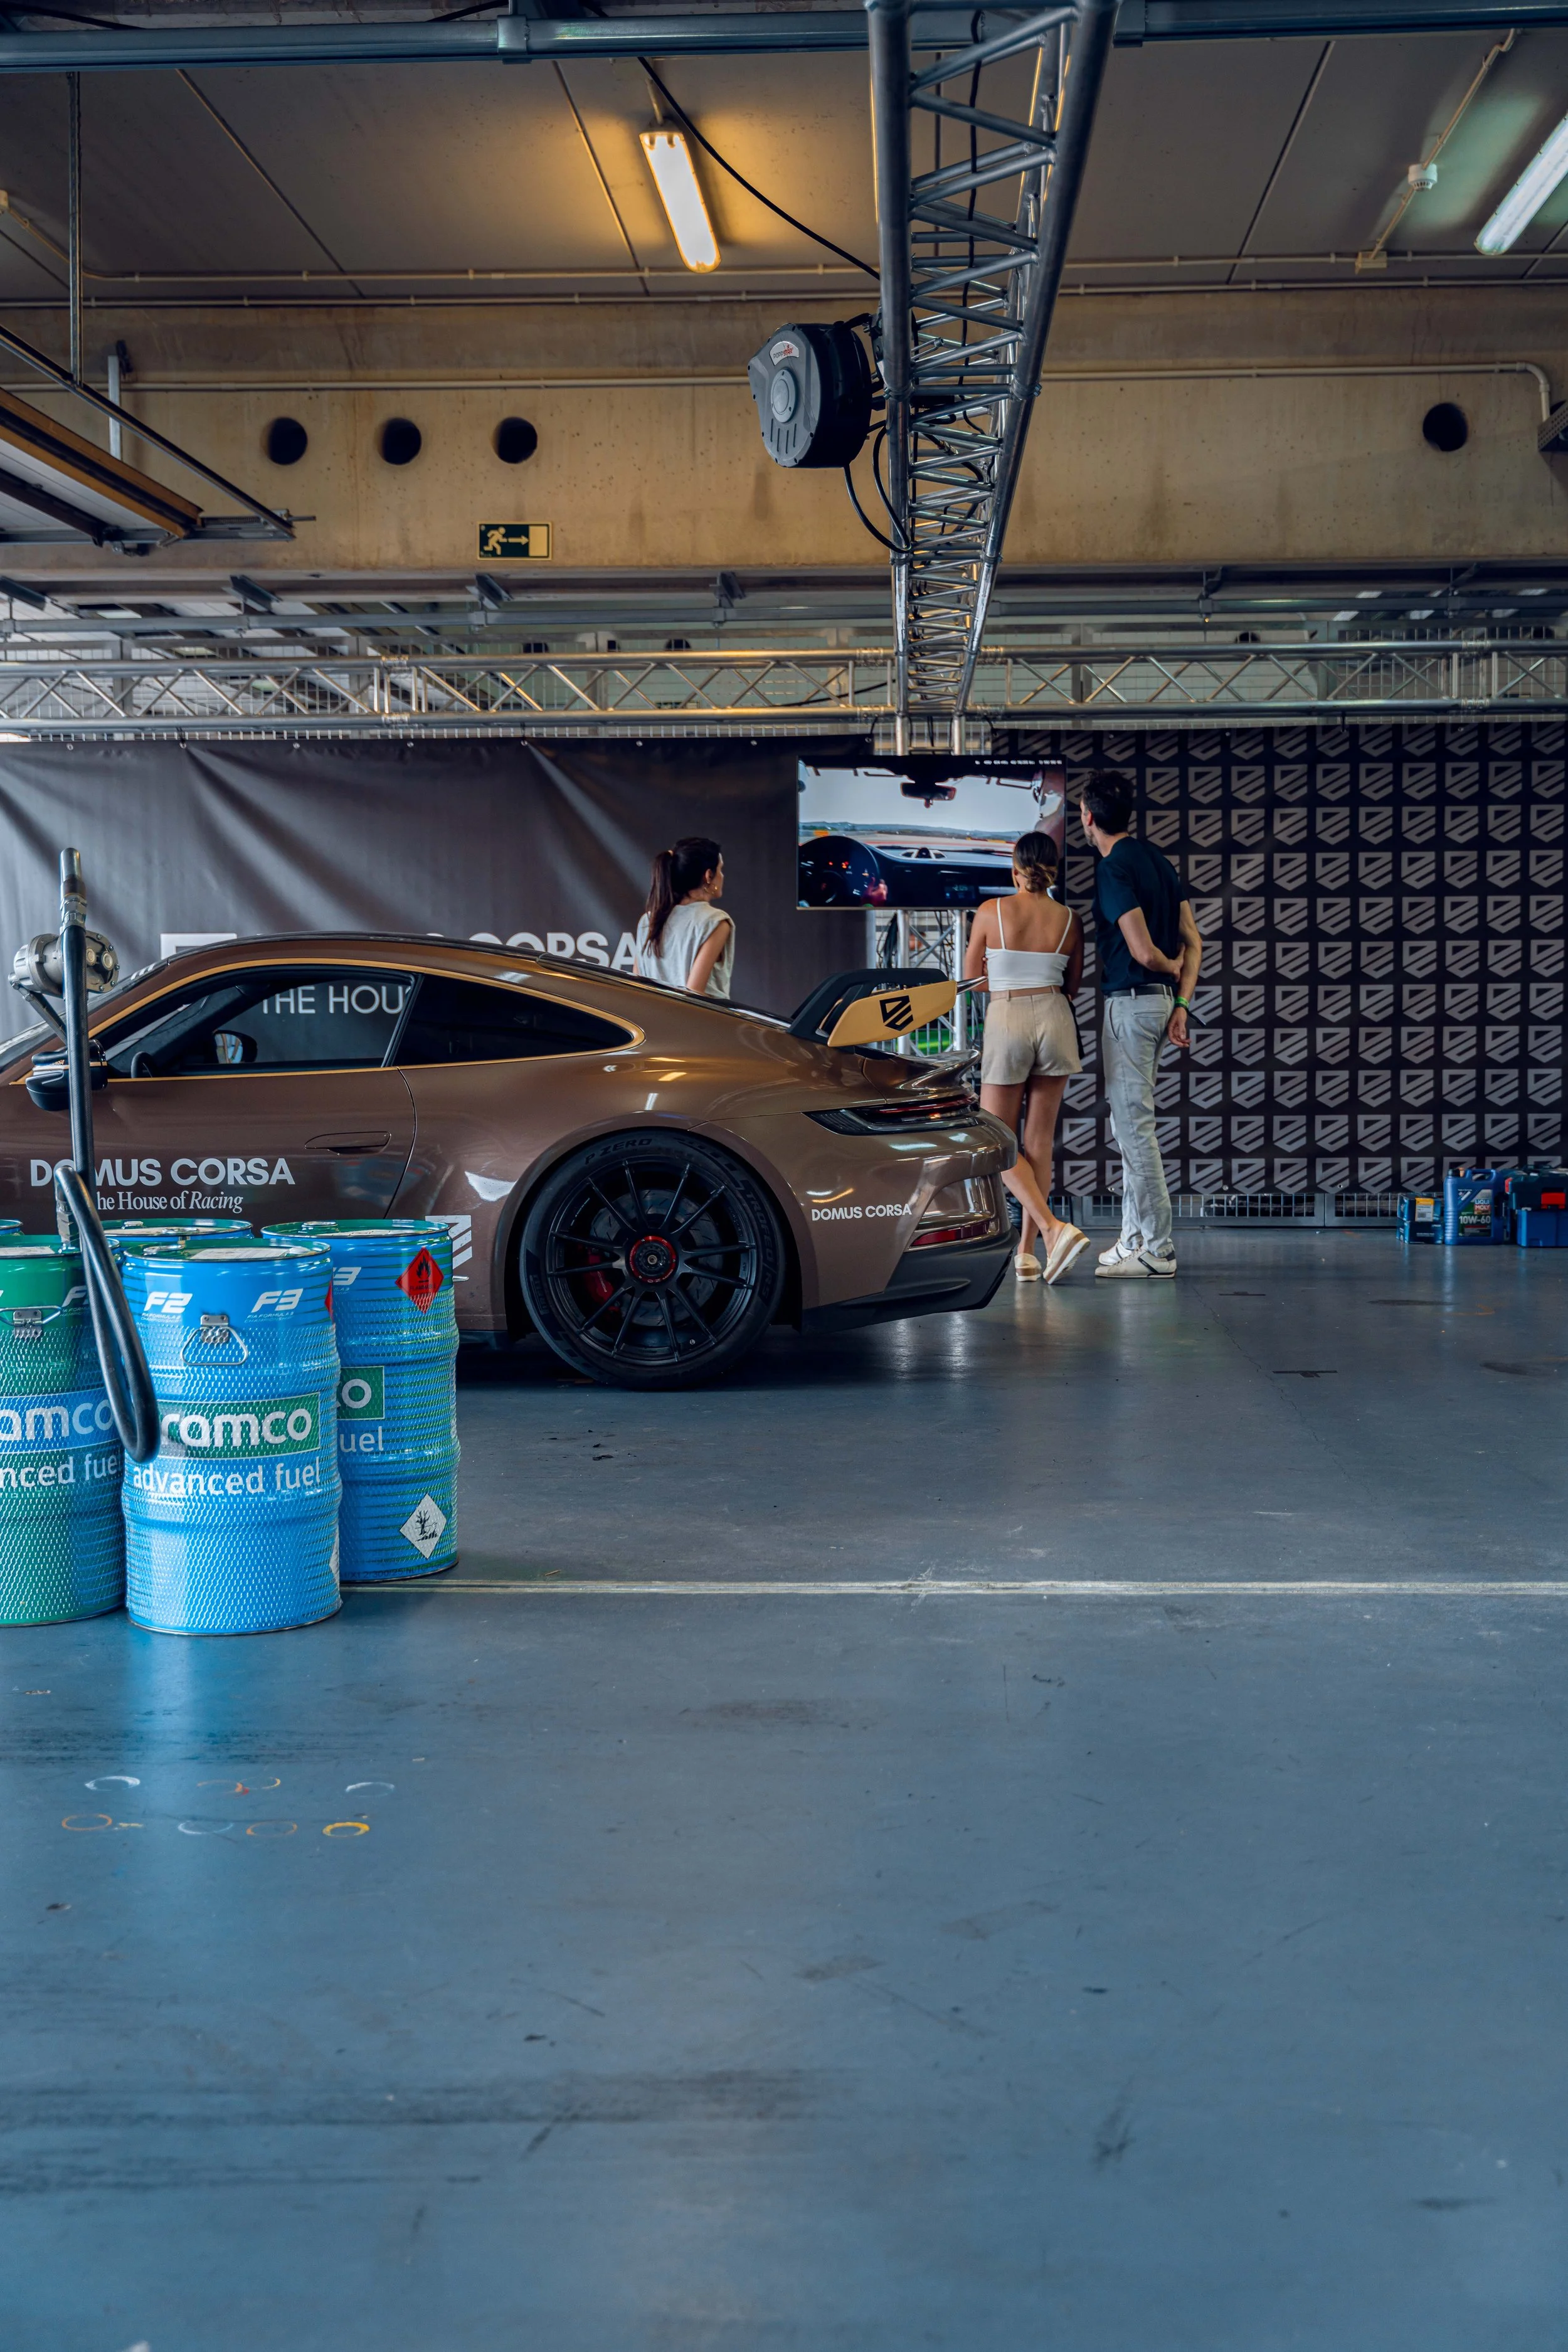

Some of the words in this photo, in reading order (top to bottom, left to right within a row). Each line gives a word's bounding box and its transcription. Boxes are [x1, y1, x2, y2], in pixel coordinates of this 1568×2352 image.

[329, 985, 411, 1014] HOU
[584, 1153, 596, 1165] P
[600, 1138, 652, 1157] ZERO
[170, 1158, 295, 1186] CORSA
[97, 1191, 115, 1211] he
[117, 1192, 167, 1210] House
[169, 1190, 189, 1210] of
[189, 1190, 243, 1214] Racing
[811, 1206, 863, 1221] DOMUS
[866, 1203, 912, 1218] CORSA
[1459, 1216, 1491, 1224] 10W-60
[333, 1266, 362, 1286] 3
[761, 1271, 773, 1300] RS
[62, 1285, 90, 1307] F
[144, 1291, 193, 1314] F2
[251, 1288, 304, 1313] F3
[160, 1409, 312, 1447] ramco
[339, 1426, 384, 1453] uel
[133, 1462, 265, 1495] advanced
[275, 1456, 320, 1491] fuel
